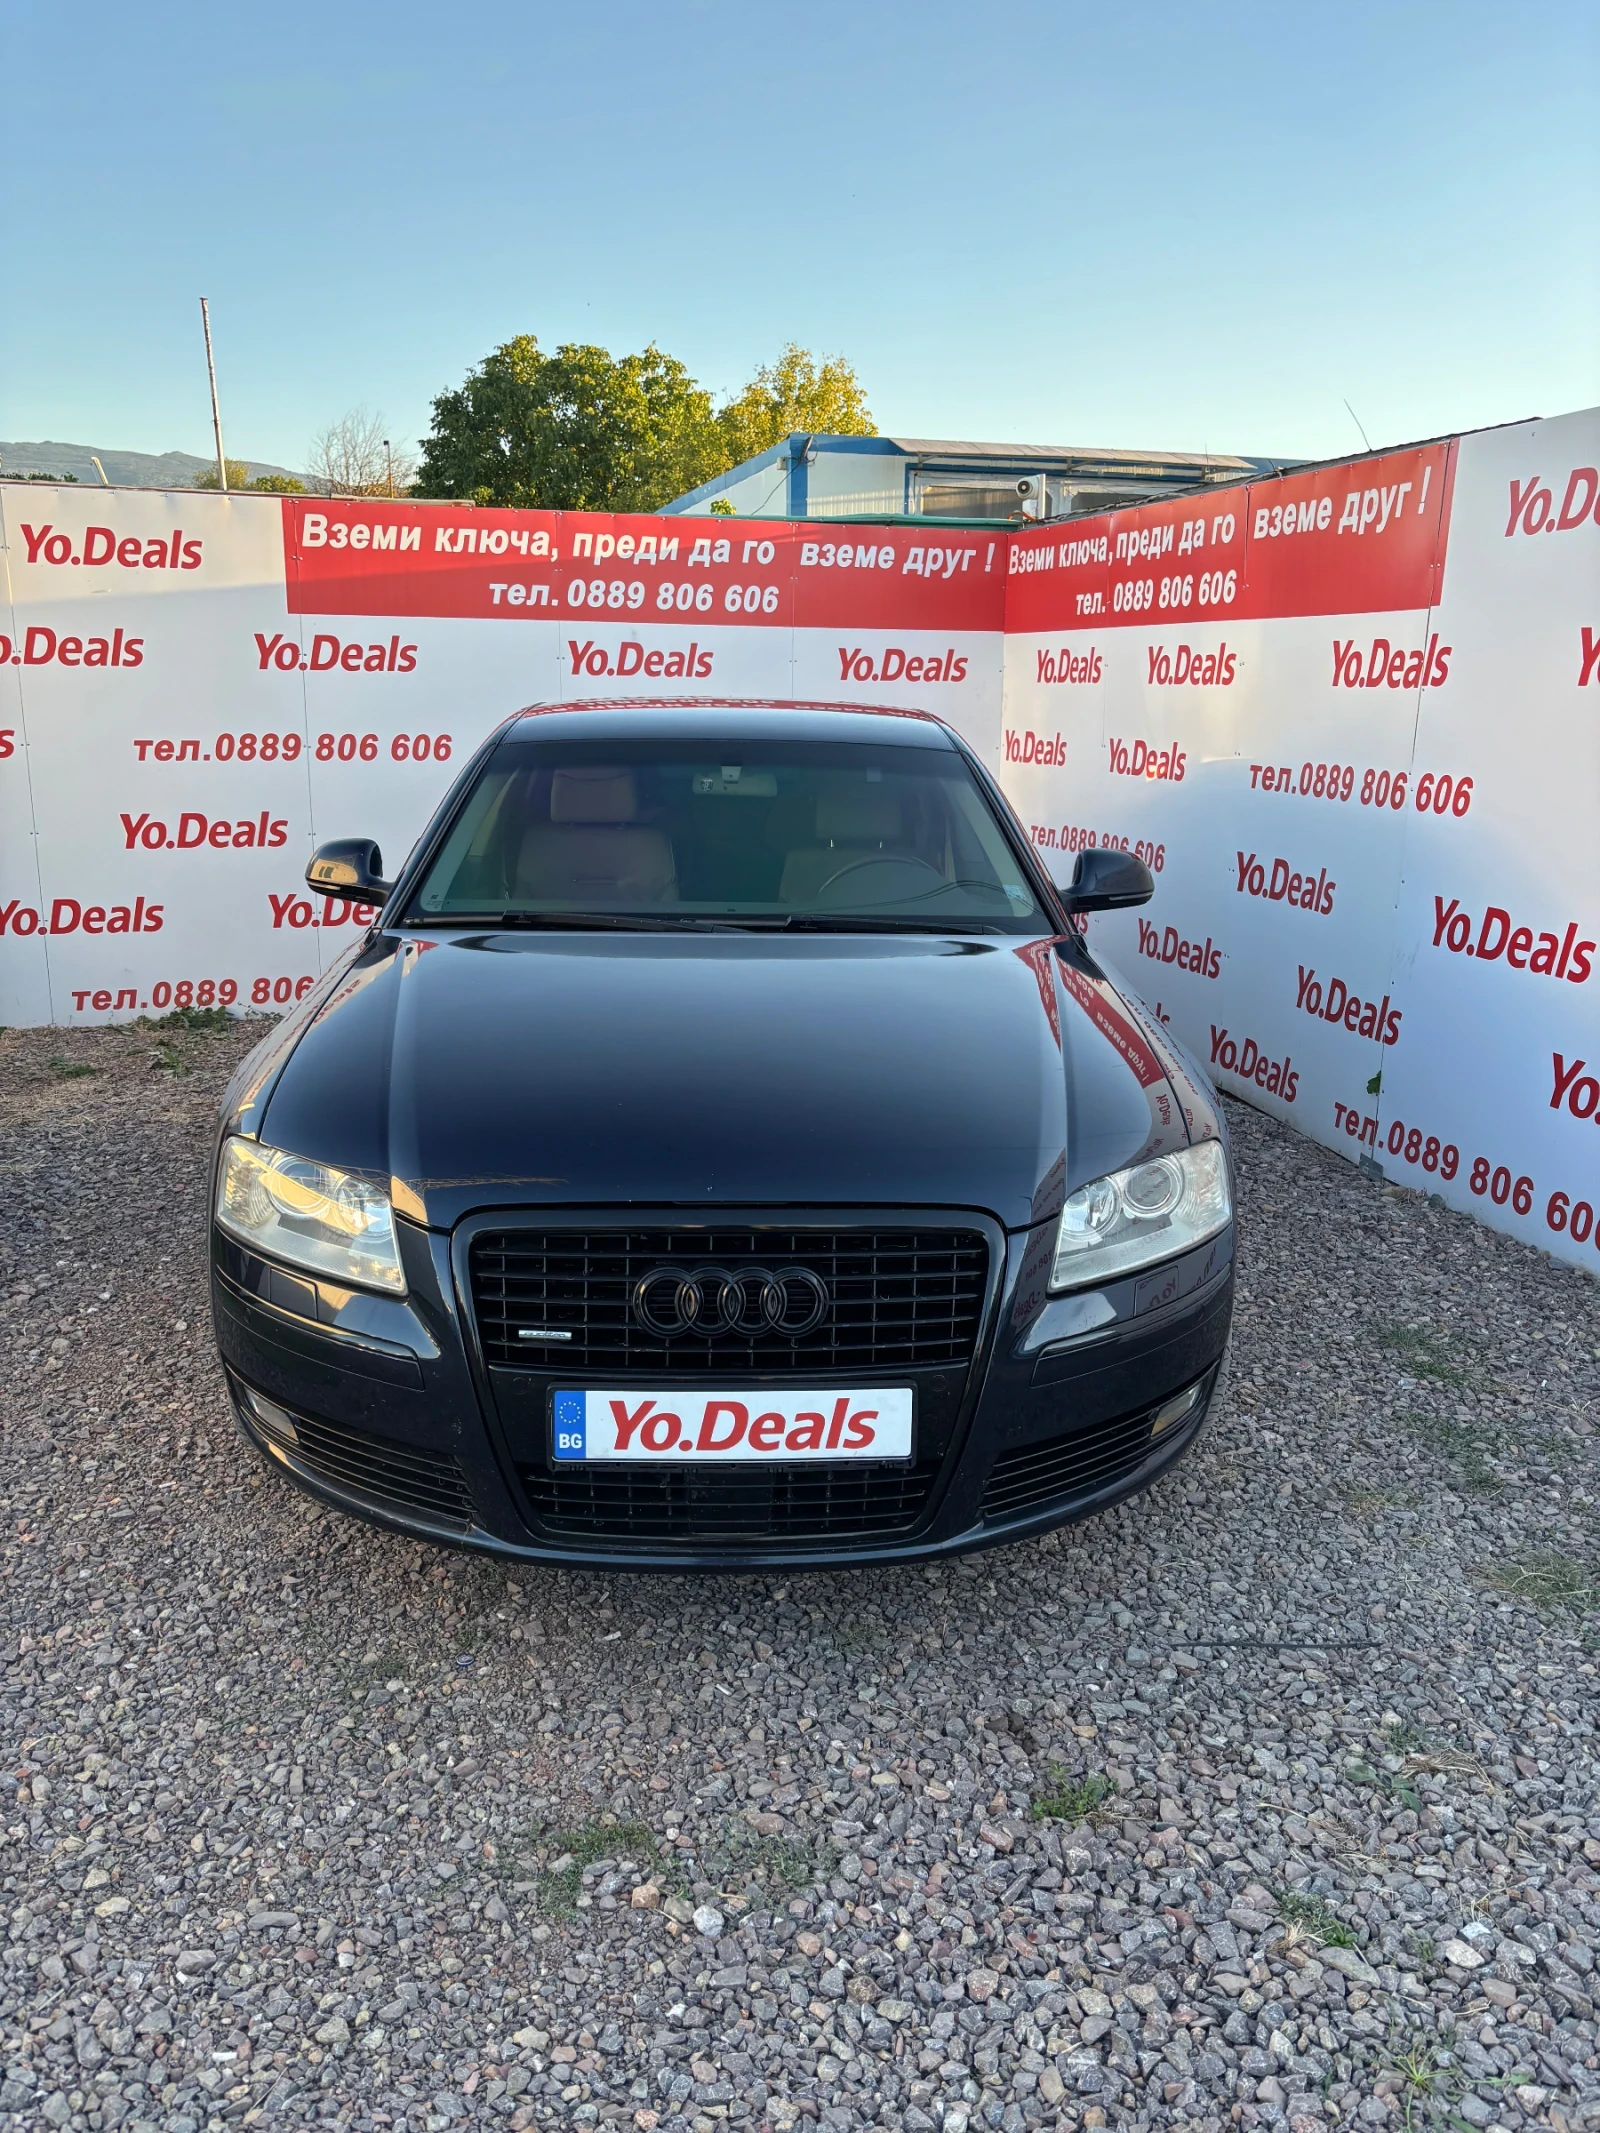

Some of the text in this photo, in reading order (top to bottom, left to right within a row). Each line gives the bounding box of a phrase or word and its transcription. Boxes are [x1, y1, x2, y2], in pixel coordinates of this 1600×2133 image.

[1009, 545, 1054, 574] Вземи
[1116, 525, 1174, 565] преди
[1178, 519, 1205, 556] да
[1211, 514, 1235, 545] го
[1254, 497, 1332, 539] вземе
[1338, 482, 1412, 535] друг
[1418, 466, 1431, 514] !
[1505, 467, 1600, 537] Yo.D
[19, 523, 203, 571] Yo.Deals
[302, 514, 995, 578] Вземи ключа, преди да го вземе друг !
[489, 579, 779, 612] тел. 0889 806 606
[1076, 570, 1236, 615] тел. 0889 806 606
[253, 633, 418, 672] Yo.Deals
[568, 640, 713, 678] Yo.Deals
[838, 648, 968, 683] Yo.Deals
[1035, 646, 1103, 685] Yo.Deals
[1147, 641, 1238, 688] Yo.Deals
[1331, 632, 1453, 690] Yo.Deals
[132, 732, 452, 762] тел.0889 806 606
[1005, 730, 1067, 767] Yo.Deals
[1109, 737, 1187, 782] Yo.Deals
[1250, 762, 1474, 817] тел.0889 806 606
[119, 811, 288, 850] Yo.Deals
[1236, 852, 1336, 915] Yo.Deals
[0, 896, 164, 936] Yo.Deals
[268, 894, 380, 928] Yo.De
[1138, 919, 1222, 979] Yo.Deals
[1432, 895, 1599, 984] Yo.Deals
[72, 978, 238, 1011] тел.0889
[1296, 966, 1403, 1045] Yo.Deals
[1210, 1026, 1300, 1102] Yo.Deals
[1469, 1157, 1535, 1215] 806
[1545, 1192, 1600, 1250] 60
[560, 1434, 581, 1448] BG
[609, 1398, 878, 1452] Yo.Deals
